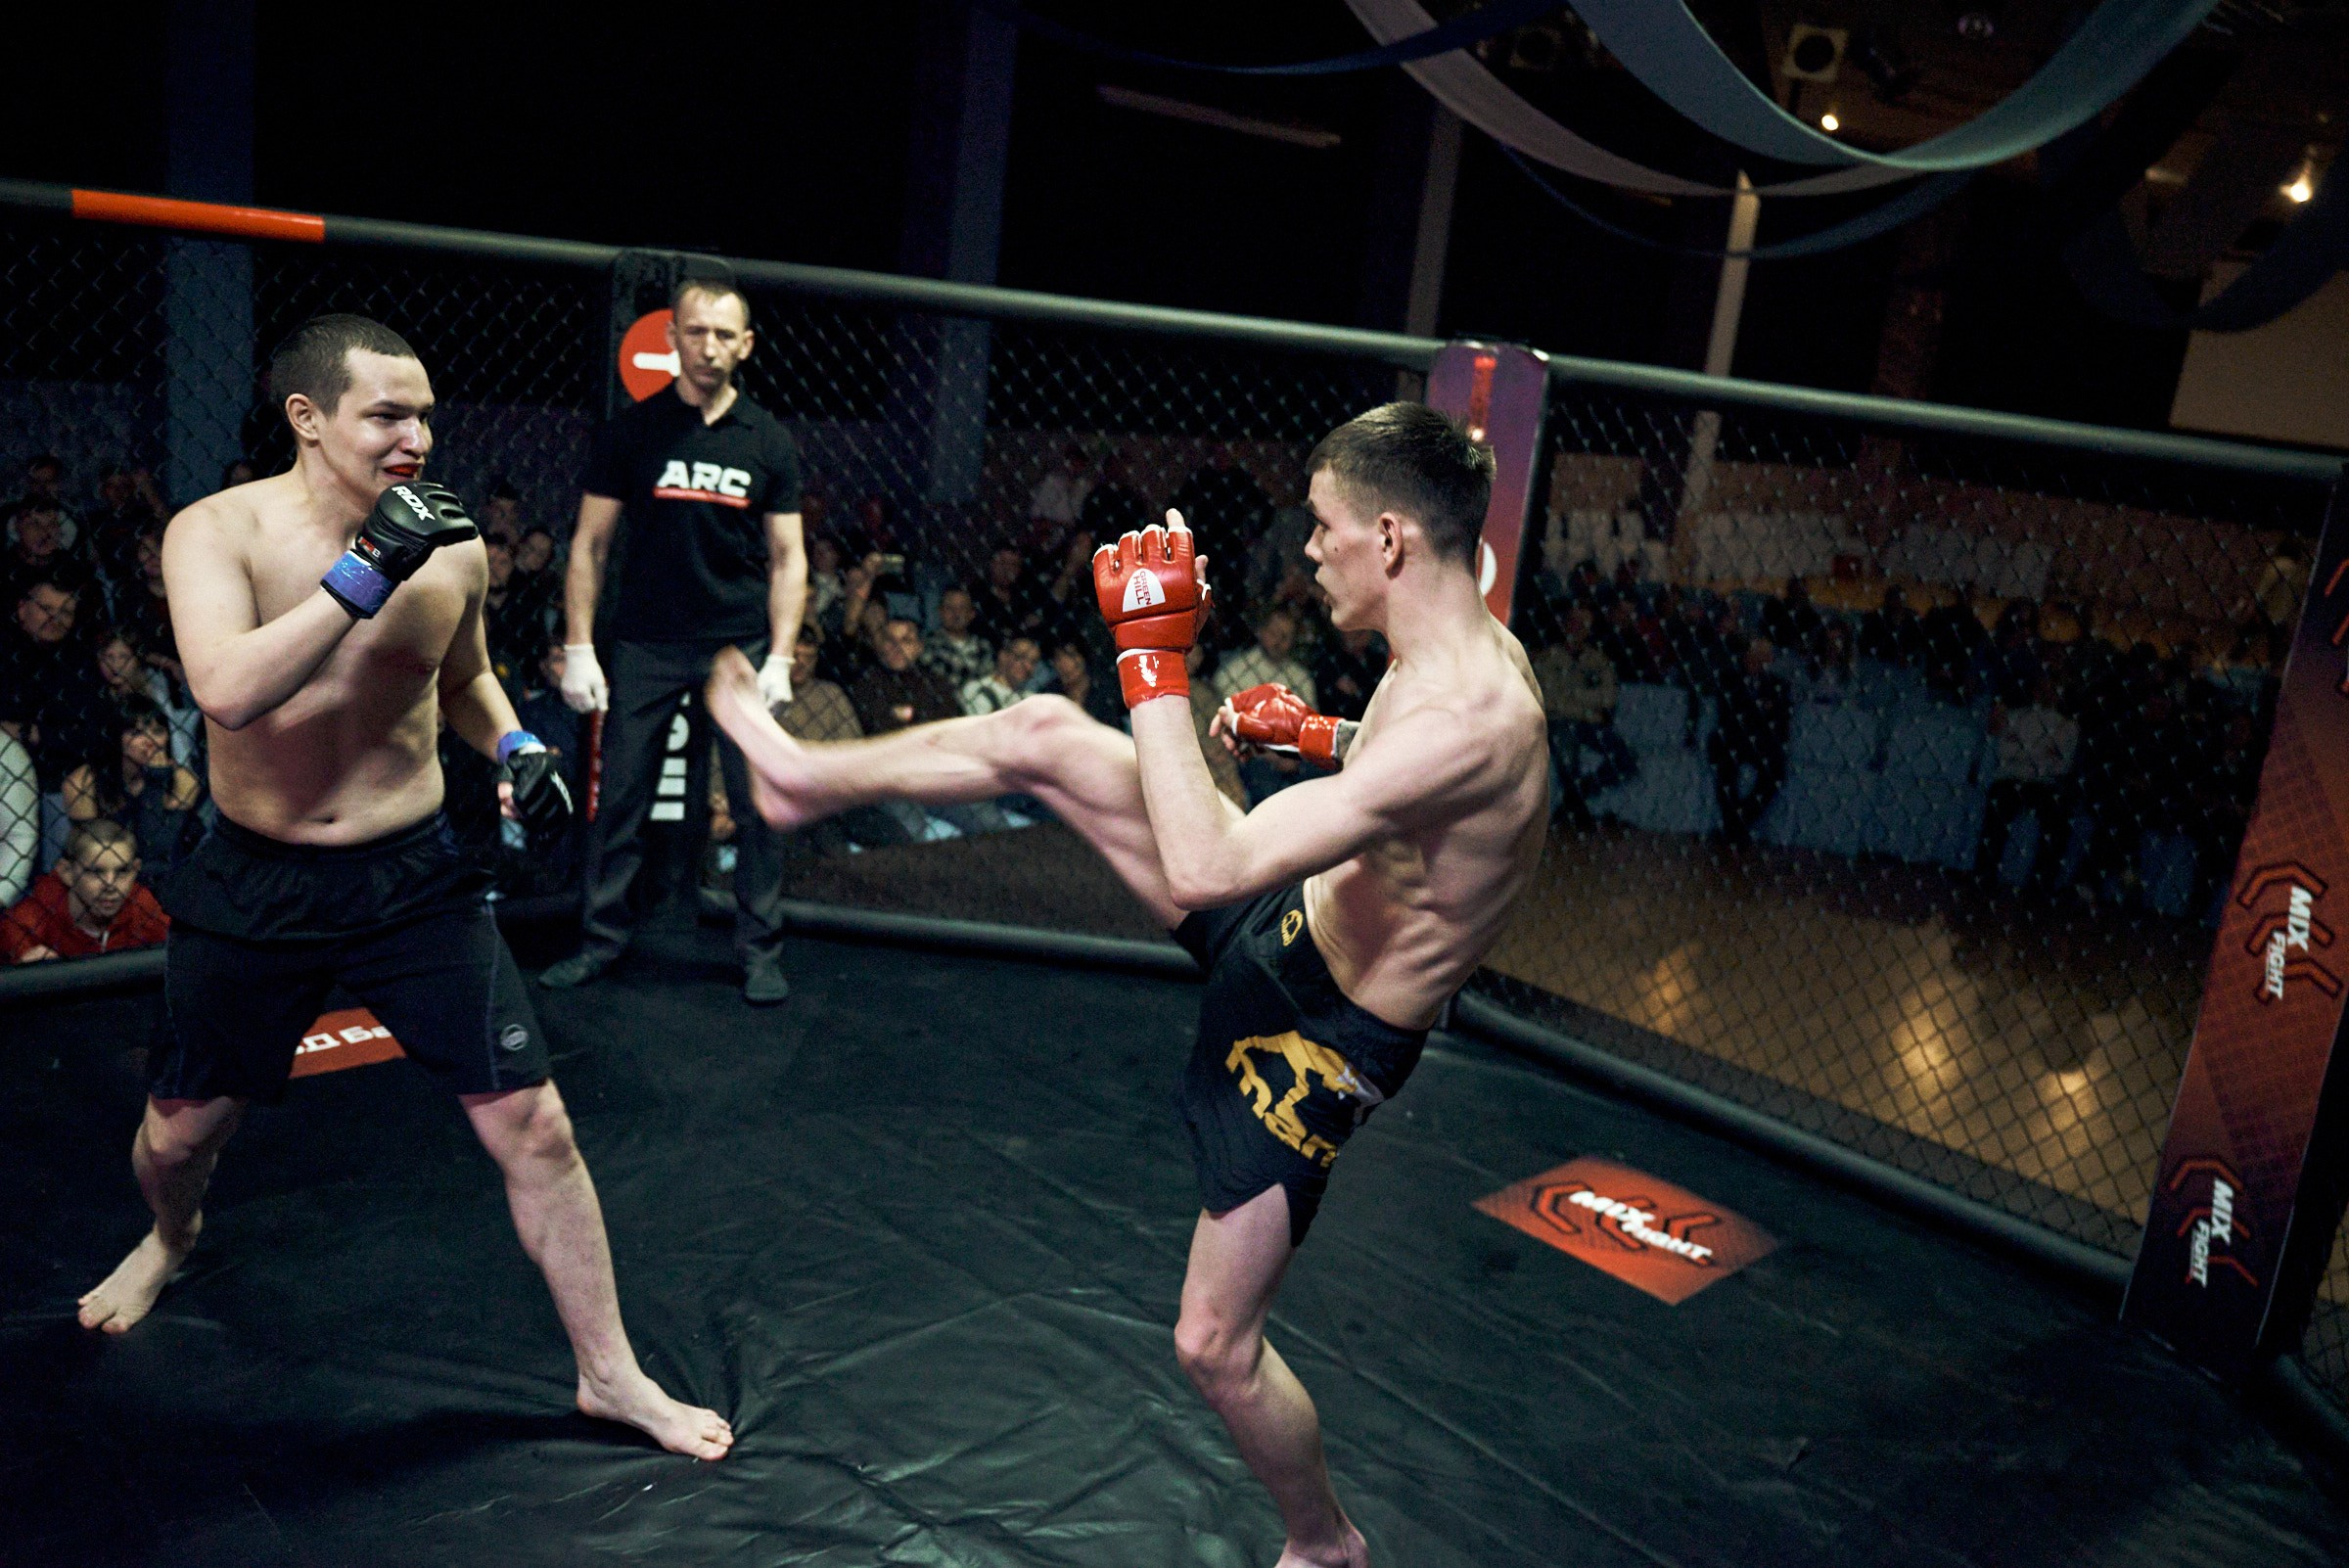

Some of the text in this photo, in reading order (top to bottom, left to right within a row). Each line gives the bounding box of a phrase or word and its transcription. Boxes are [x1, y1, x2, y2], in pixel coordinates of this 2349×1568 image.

[657, 460, 752, 497] ARC
[392, 485, 436, 521] RDX
[1133, 576, 1144, 605] HILL
[1140, 571, 1152, 605] GREEN
[2287, 885, 2313, 952] MIX
[2212, 1176, 2234, 1246] MIX
